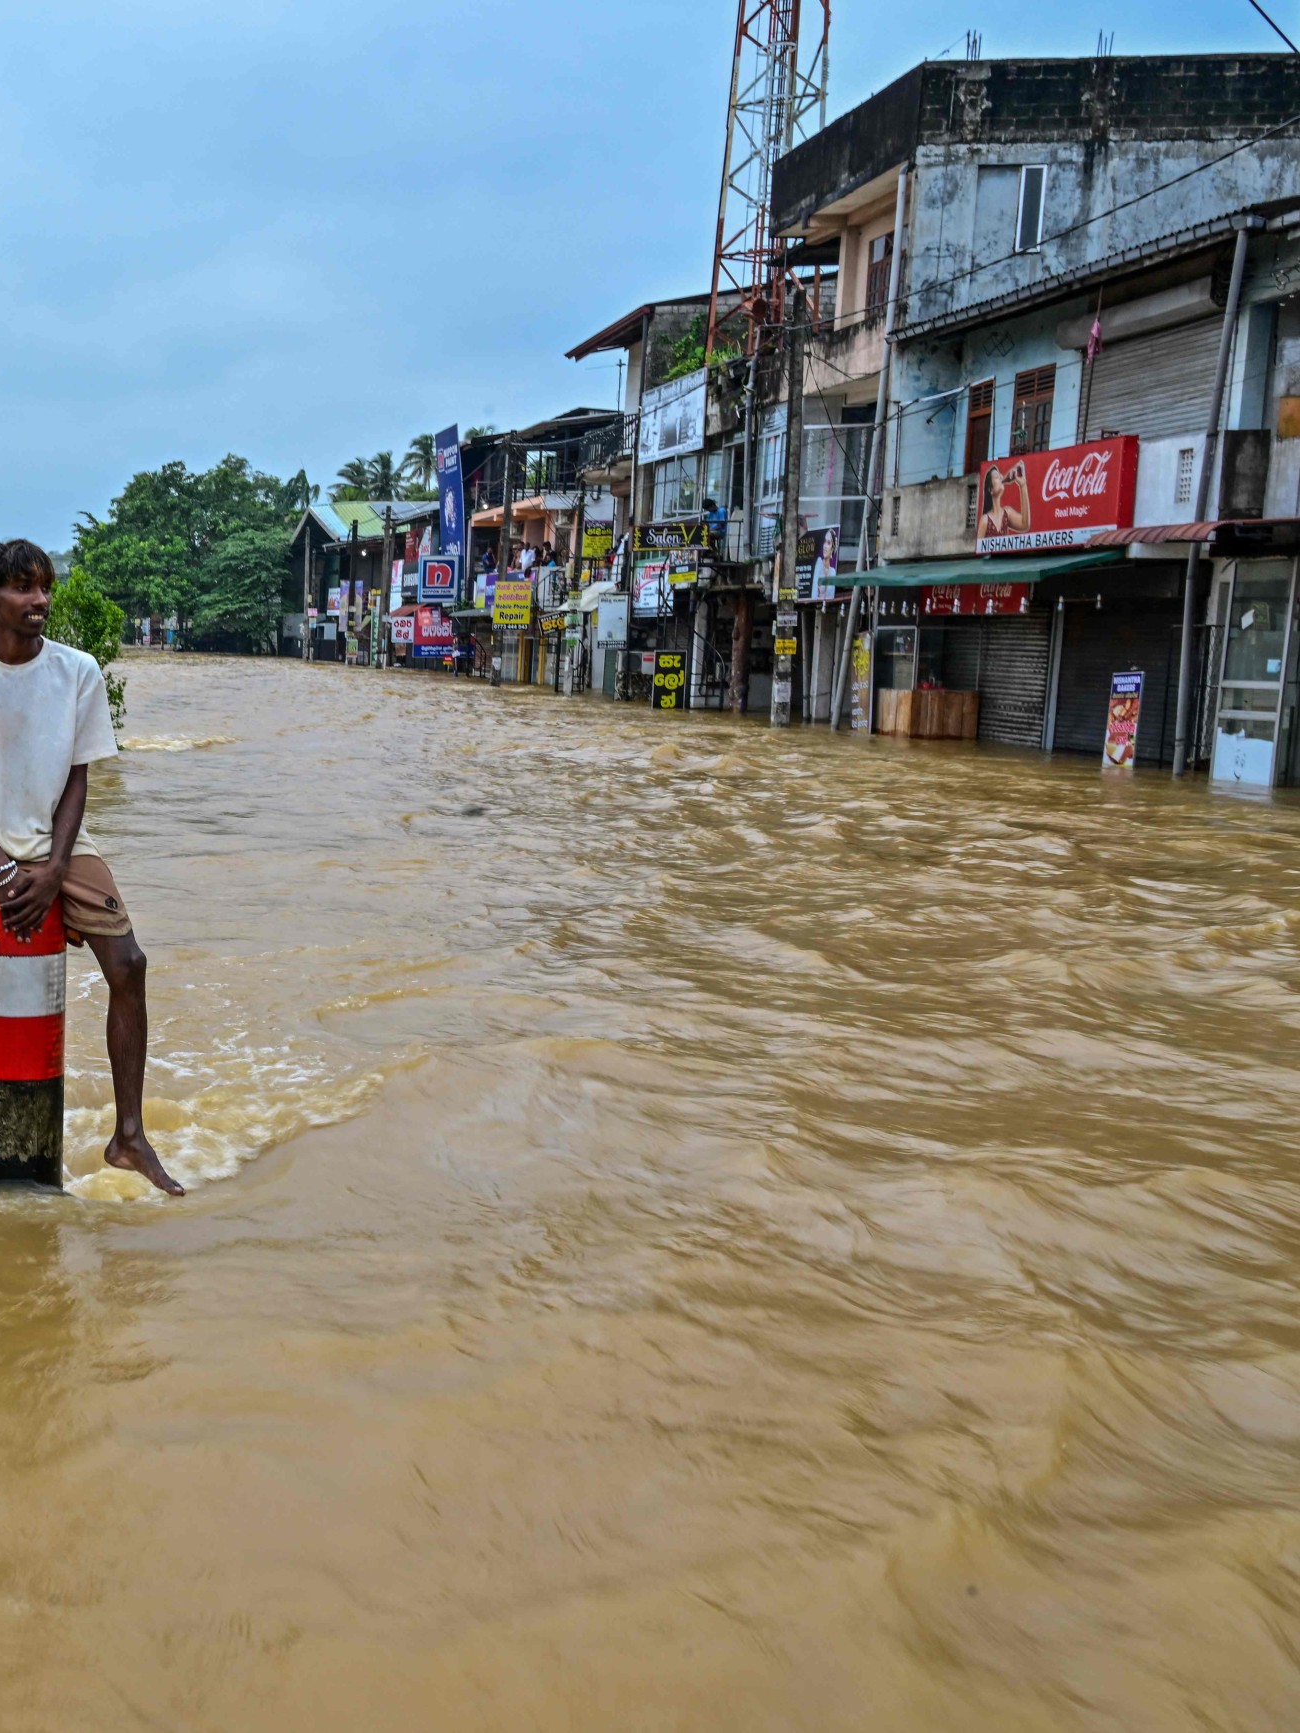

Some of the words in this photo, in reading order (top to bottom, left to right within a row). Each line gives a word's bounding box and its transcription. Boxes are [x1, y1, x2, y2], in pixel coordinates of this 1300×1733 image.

[443, 444, 458, 456] NIPPON
[445, 455, 457, 468] PAINT
[1041, 450, 1113, 502] Coca-Cola
[1054, 507, 1069, 518] Real
[1069, 505, 1088, 518] Magic
[646, 527, 681, 545] Salon
[981, 535, 1032, 552] NISHANTHA
[1035, 530, 1074, 547] BAKERS
[499, 612, 524, 622] Repair
[1113, 676, 1141, 684] NISHANTHA
[1116, 684, 1136, 692] BAKERS
